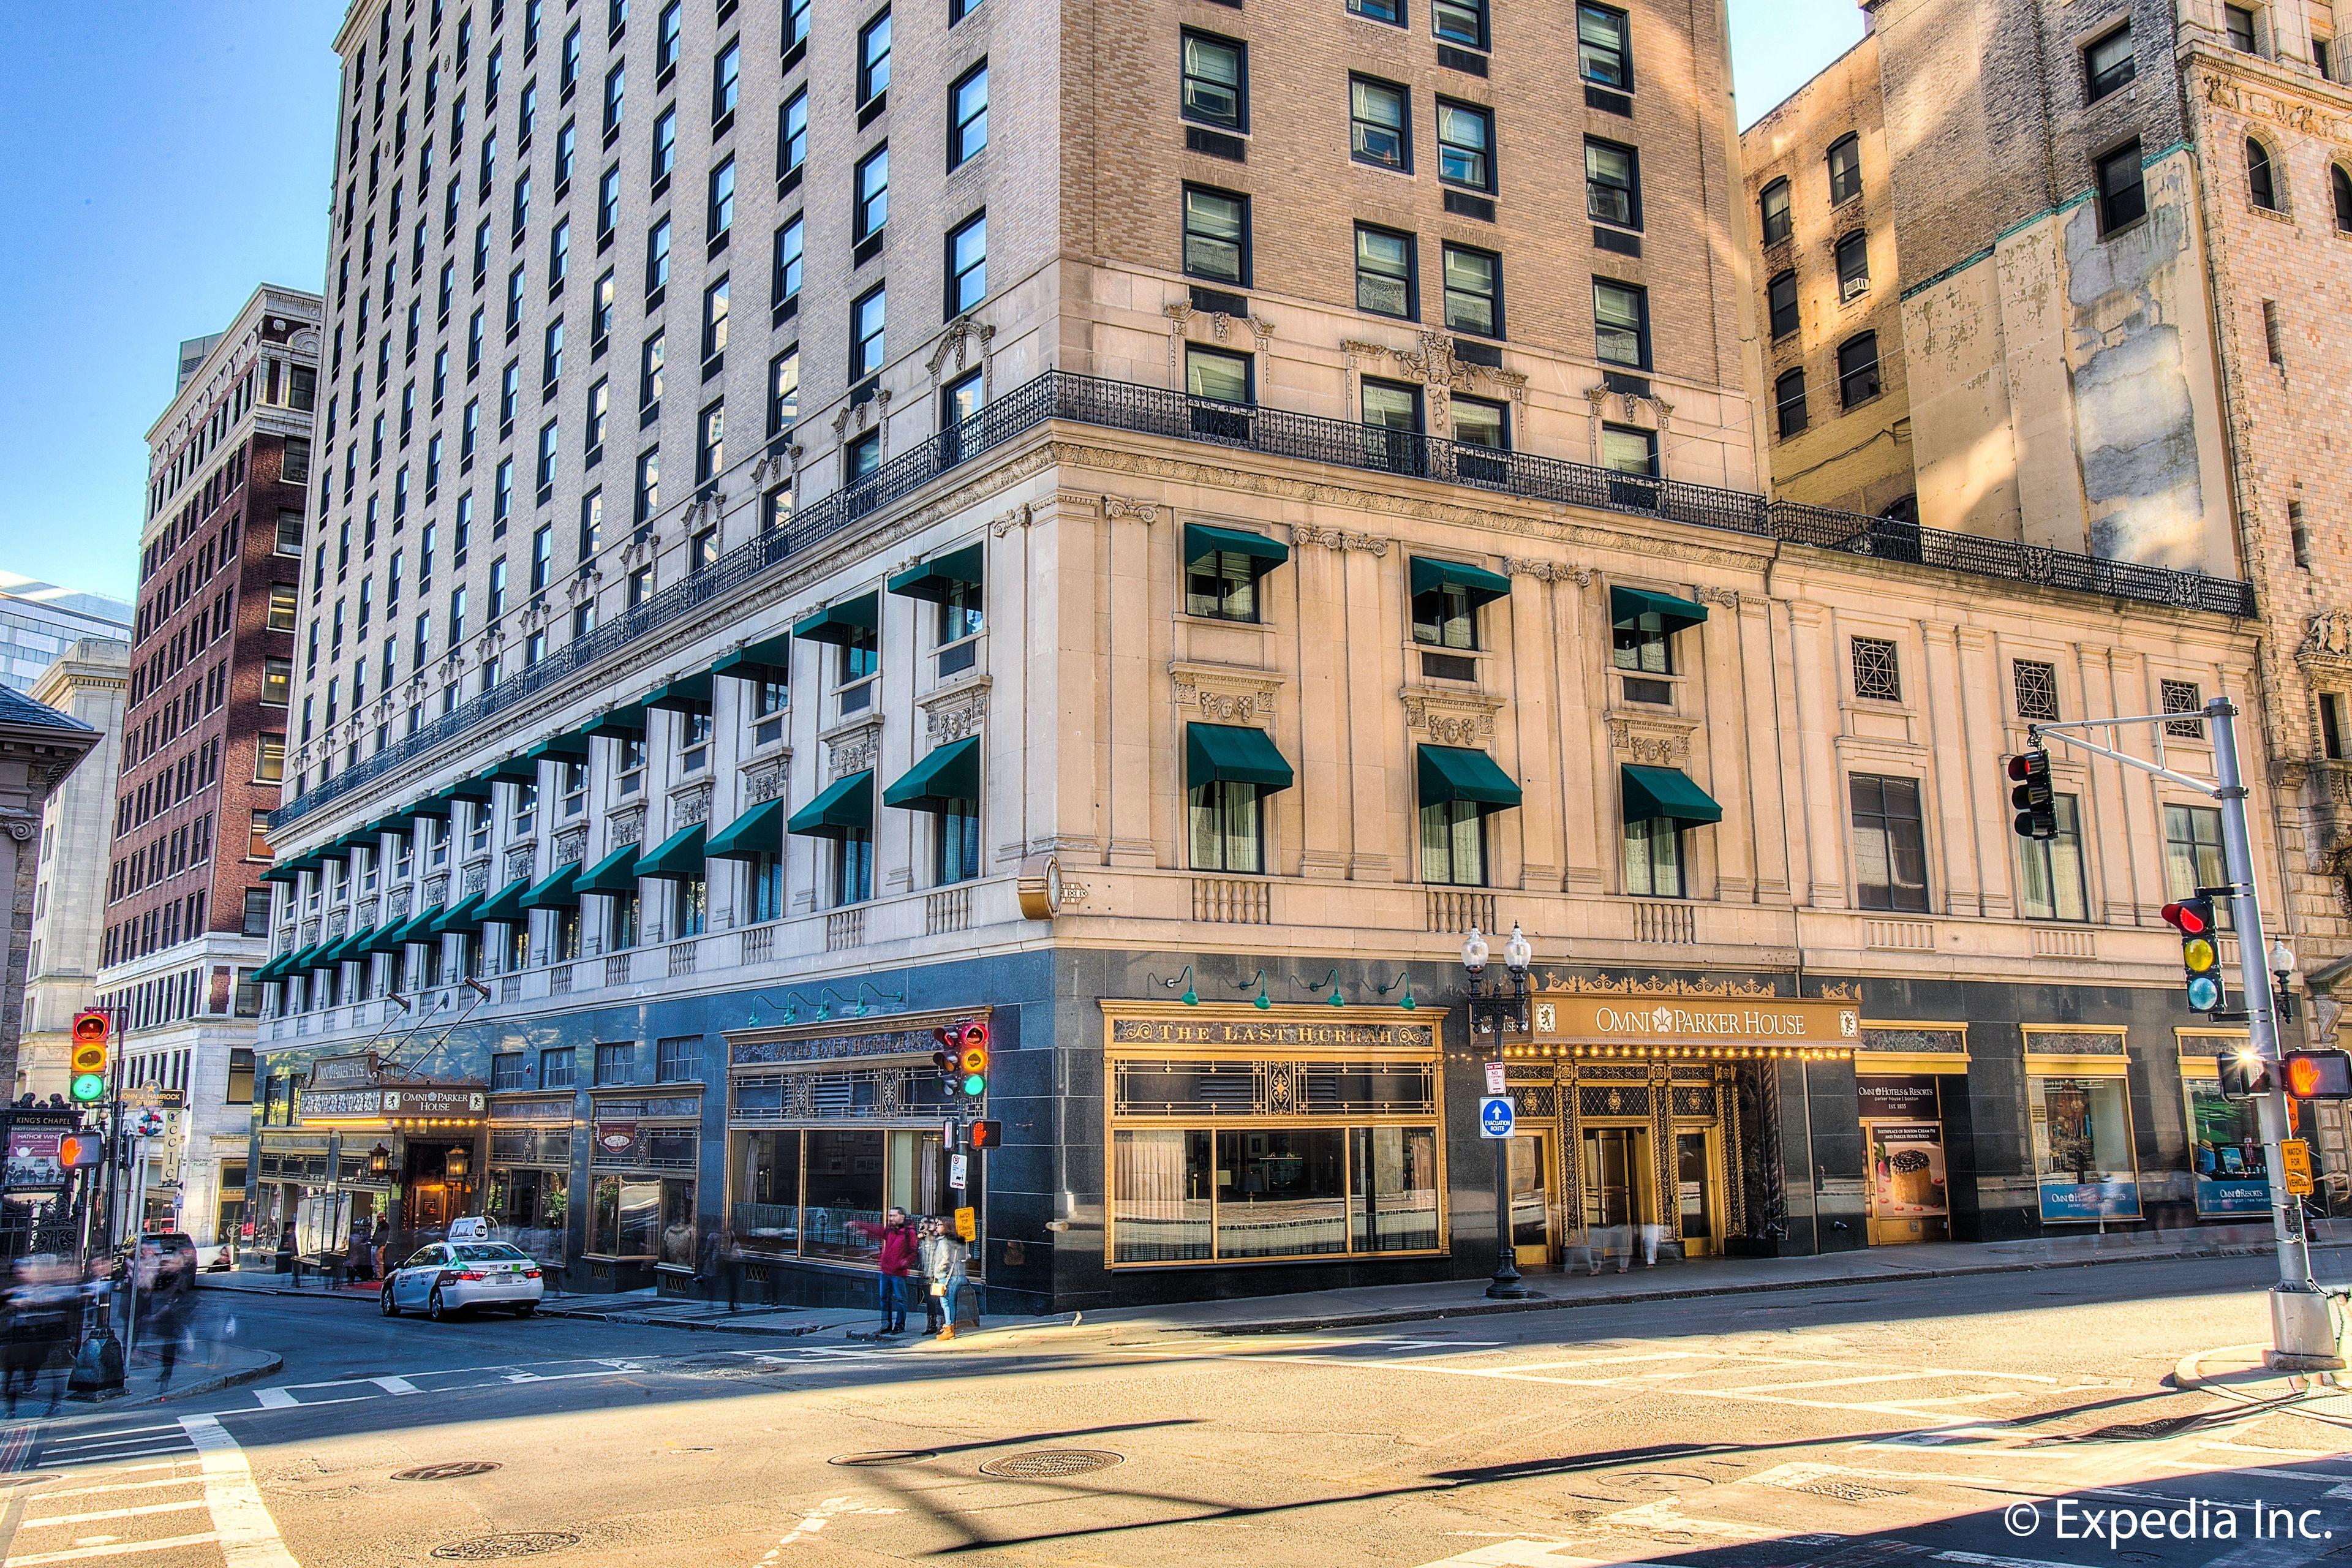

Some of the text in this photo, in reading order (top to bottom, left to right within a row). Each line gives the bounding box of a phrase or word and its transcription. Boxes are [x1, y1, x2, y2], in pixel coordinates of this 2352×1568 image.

[1596, 1007, 1806, 1035] OMNI PARKER HOUSE
[1159, 1025, 1392, 1042] THE LAST HURRAH
[790, 1036, 905, 1057] THE LAST HURRAH
[349, 1062, 365, 1077] HOUSE
[402, 1092, 468, 1102] OMNI PARKER
[420, 1102, 450, 1112] HOUSE
[2051, 1193, 2068, 1202] OMNI
[2220, 1189, 2235, 1197] OMNI
